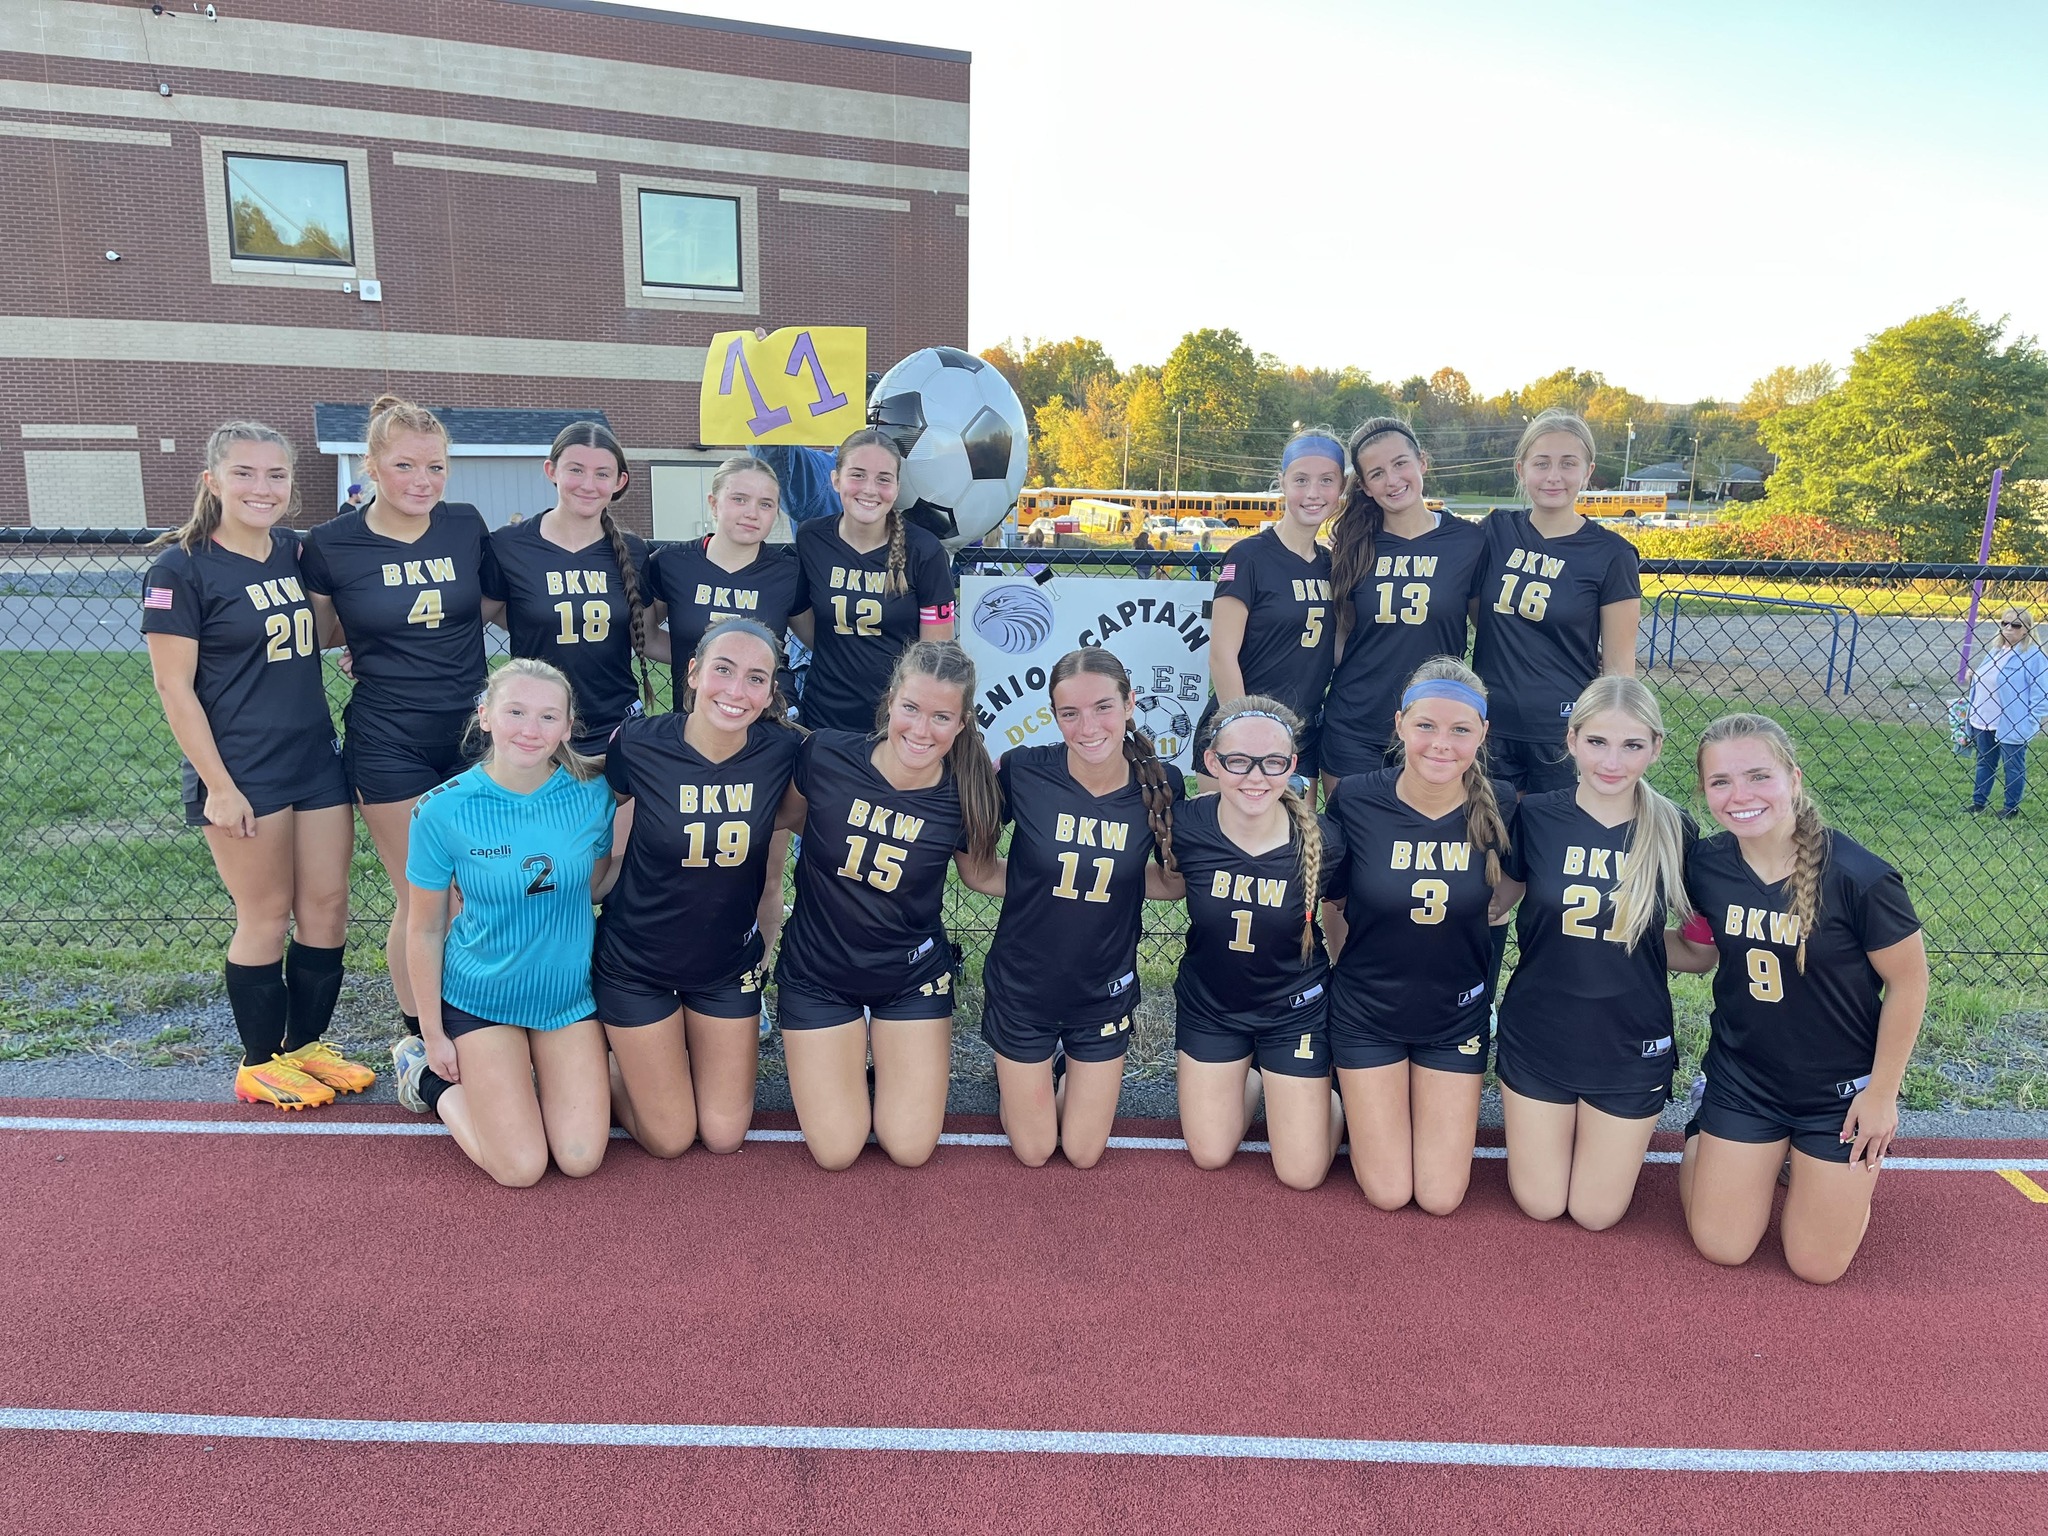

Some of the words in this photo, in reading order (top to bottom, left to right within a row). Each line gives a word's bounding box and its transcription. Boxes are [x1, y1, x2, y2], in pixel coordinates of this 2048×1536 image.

[719, 331, 848, 437] 11
[381, 557, 456, 586] BKW
[546, 569, 608, 595] BKW
[829, 566, 887, 594] BKW
[1374, 555, 1439, 578] BKW
[1505, 547, 1566, 580] BKW
[245, 576, 306, 611] BKW
[407, 589, 445, 629] 4
[694, 583, 759, 610] BKW
[1374, 582, 1431, 626] 13
[1492, 573, 1552, 623] 16
[265, 608, 314, 663] 20
[553, 600, 611, 644] 18
[830, 595, 882, 636] 12
[1078, 599, 1210, 653] CAPTAIN
[1301, 607, 1325, 648] 5
[975, 666, 1048, 732] ENIO
[1004, 704, 1053, 746] DCS
[1158, 736, 1177, 755] 11
[679, 783, 754, 814] BKW
[847, 798, 925, 843] BKW
[1055, 812, 1129, 852] BKW
[470, 844, 511, 858] capelli
[681, 820, 751, 868] 19
[837, 834, 908, 893] 15
[1390, 840, 1471, 871] BKW
[520, 852, 558, 898] 2
[1052, 851, 1115, 903] 11
[1210, 869, 1288, 908] BKW
[1410, 878, 1450, 925] 3
[1562, 884, 1631, 943] 21
[1228, 909, 1256, 953] 1
[1725, 904, 1800, 946] BKW
[1746, 948, 1784, 1003] 9
